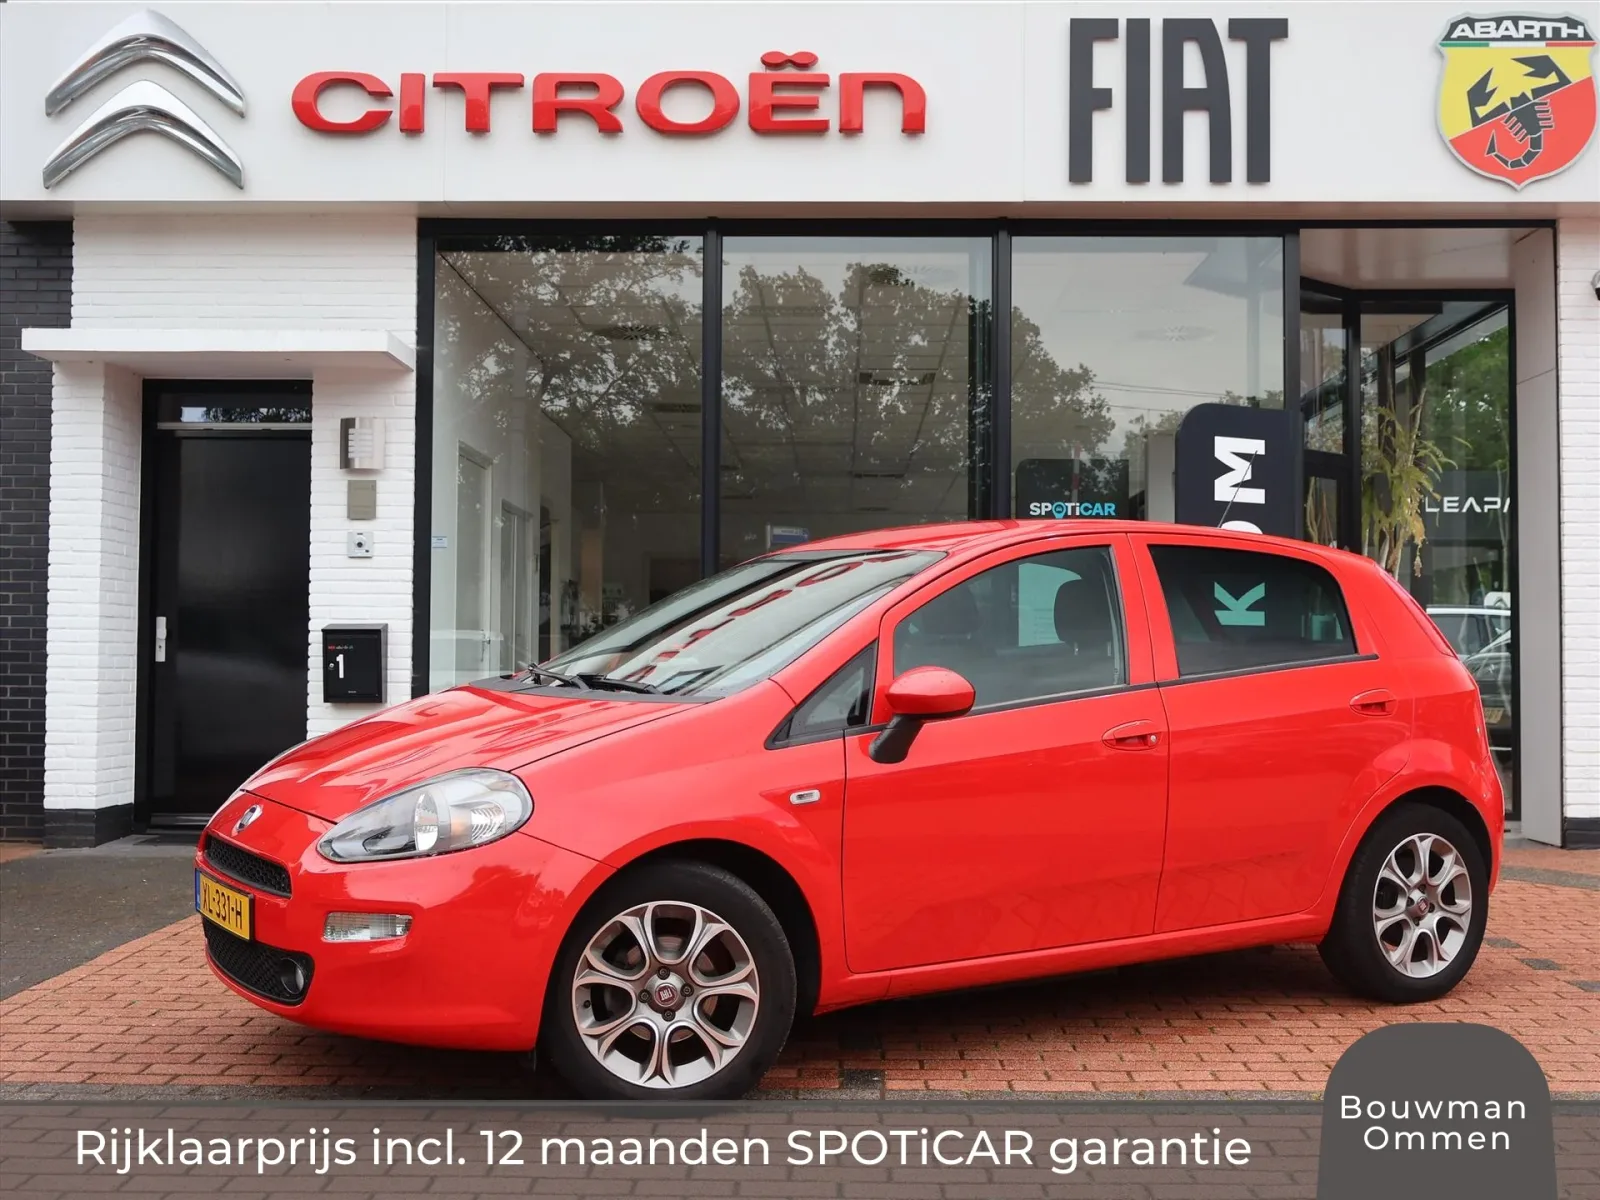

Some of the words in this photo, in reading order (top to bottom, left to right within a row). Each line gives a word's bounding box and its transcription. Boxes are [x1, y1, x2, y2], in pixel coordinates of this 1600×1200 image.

[1450, 19, 1585, 39] ABARTH
[1069, 18, 1289, 184] FIAT
[336, 653, 345, 679] 1
[203, 881, 243, 931] XL-331-H
